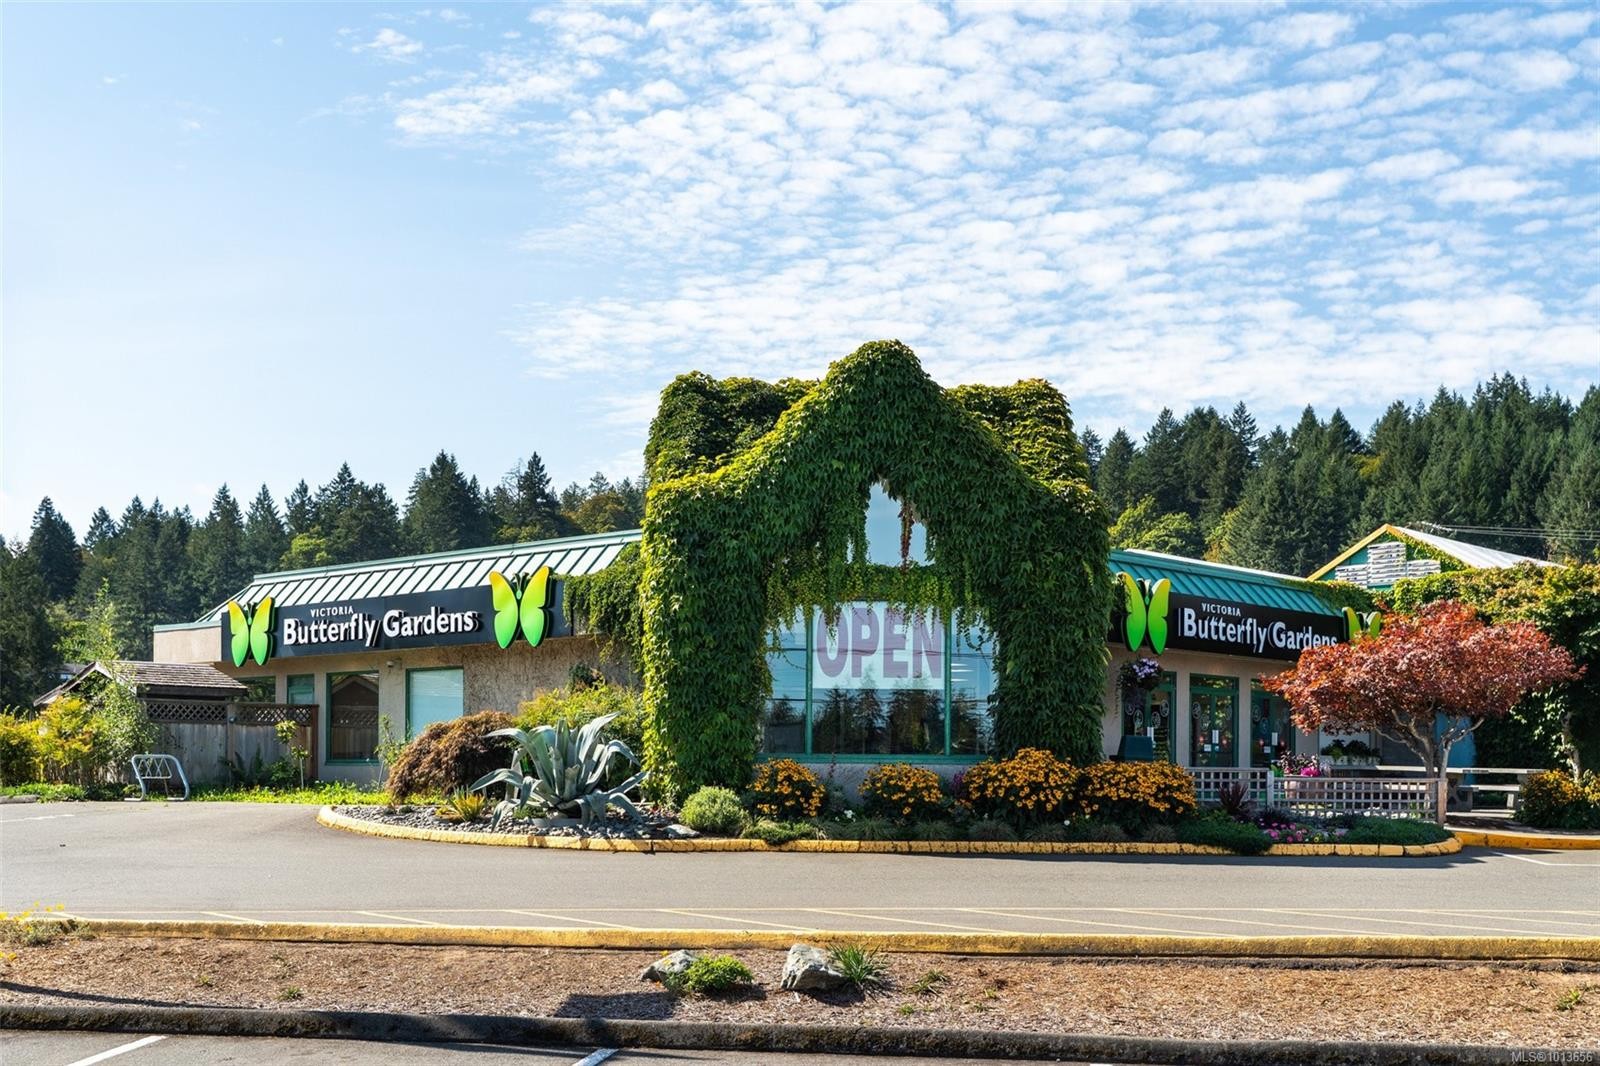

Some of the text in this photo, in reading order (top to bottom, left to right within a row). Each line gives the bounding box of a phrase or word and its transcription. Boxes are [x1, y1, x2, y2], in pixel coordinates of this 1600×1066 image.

[283, 606, 475, 647] Butterfly Gardens
[310, 606, 354, 618] VICTORIA
[1201, 602, 1241, 617] VICTORIA
[816, 607, 942, 678] OPEN
[1183, 607, 1338, 654] Butterfly Gardens
